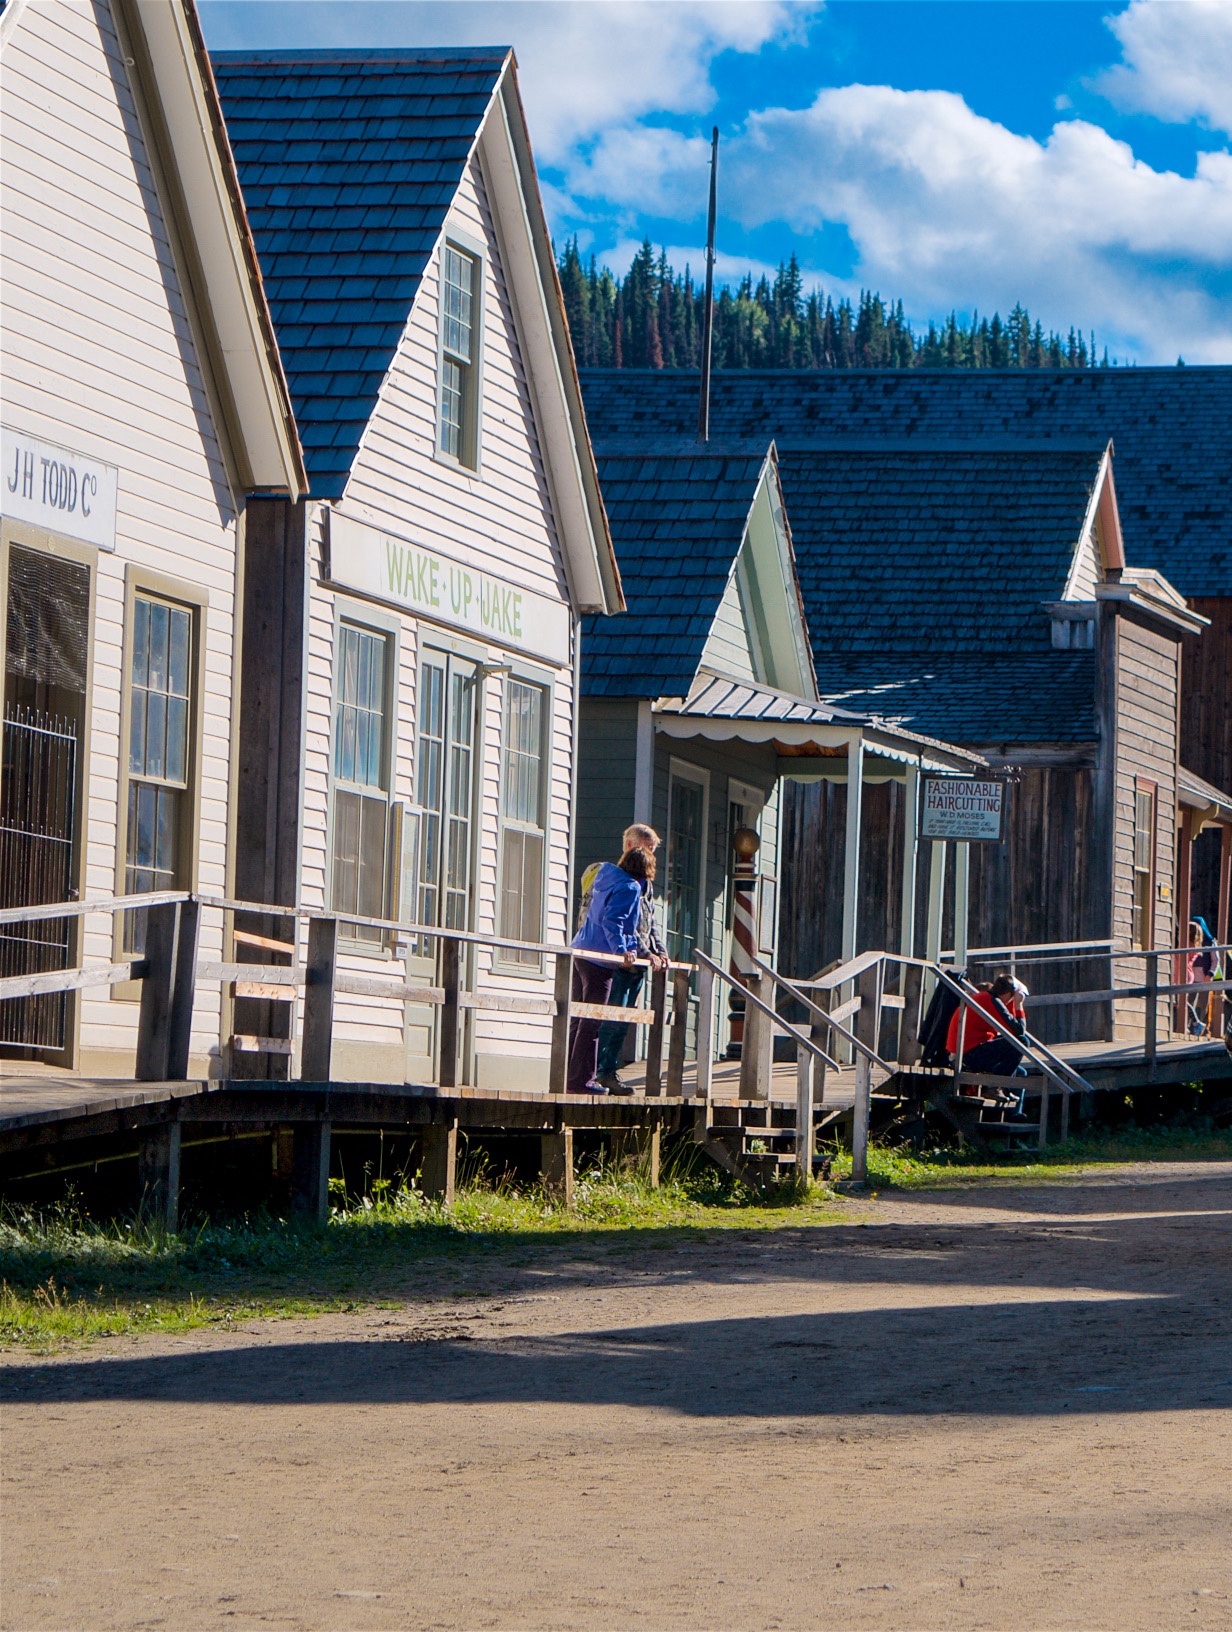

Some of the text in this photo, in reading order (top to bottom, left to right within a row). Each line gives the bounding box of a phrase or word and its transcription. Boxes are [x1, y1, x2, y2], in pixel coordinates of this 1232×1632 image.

[40, 457, 77, 513] TODD
[386, 540, 522, 638] WAKE UP JAKE
[927, 796, 1000, 812] HAIRCUTTING
[928, 781, 1001, 797] FASHIONABLE
